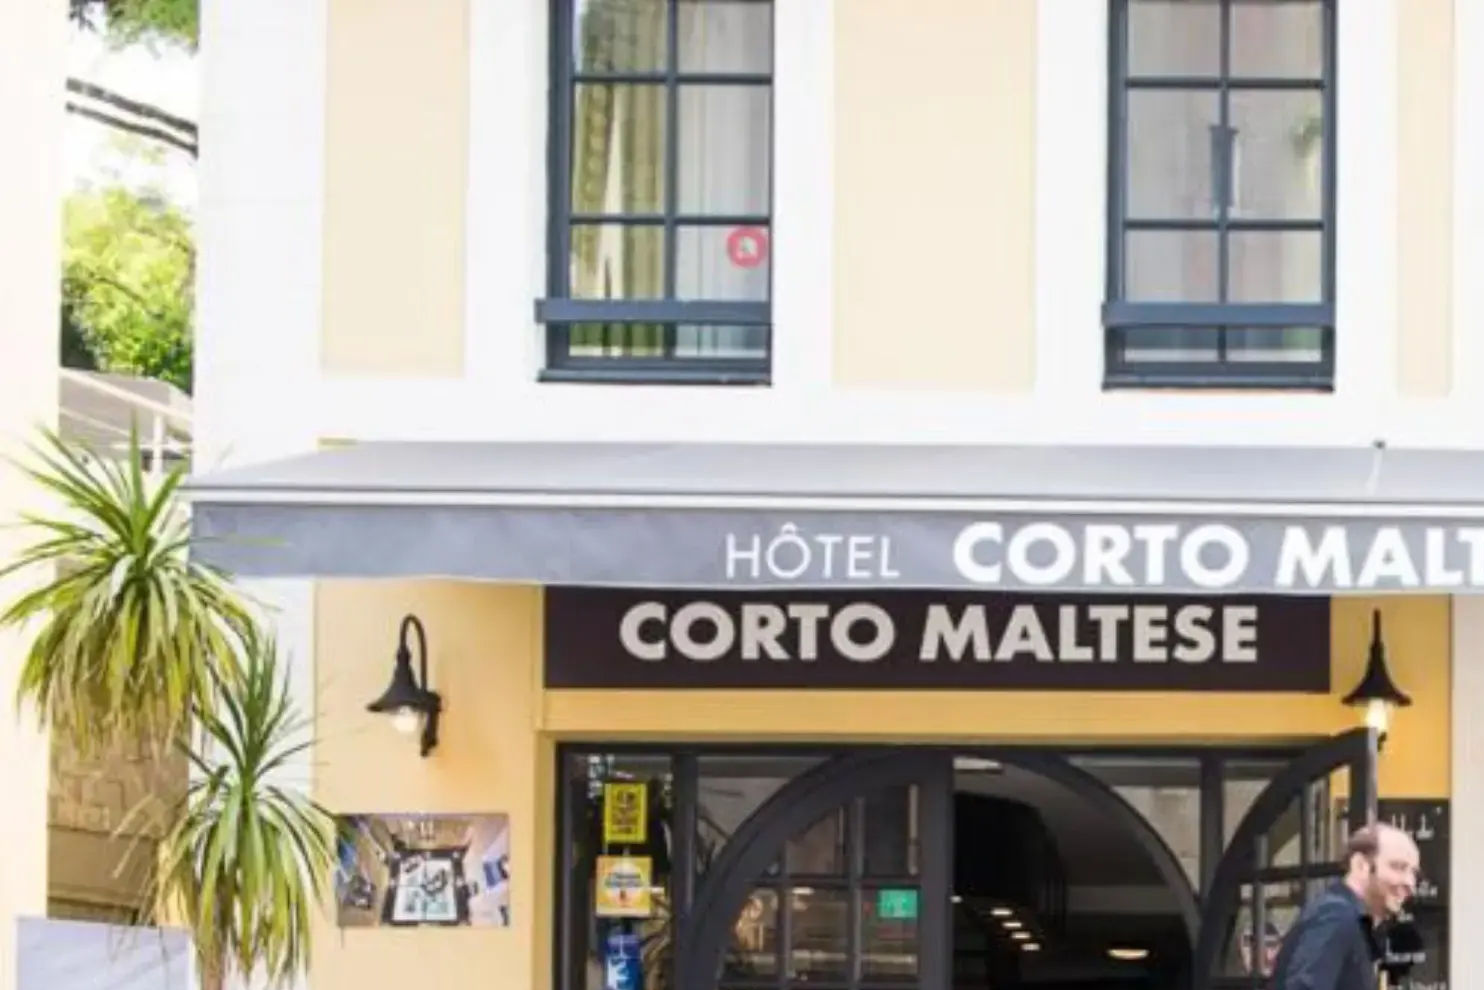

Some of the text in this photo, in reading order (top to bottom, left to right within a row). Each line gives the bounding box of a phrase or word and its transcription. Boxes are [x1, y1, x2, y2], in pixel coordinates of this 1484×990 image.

[725, 523, 900, 578] HÔTEL
[953, 521, 1249, 588] CORTO
[619, 601, 1258, 663] CORTO MALTESE
